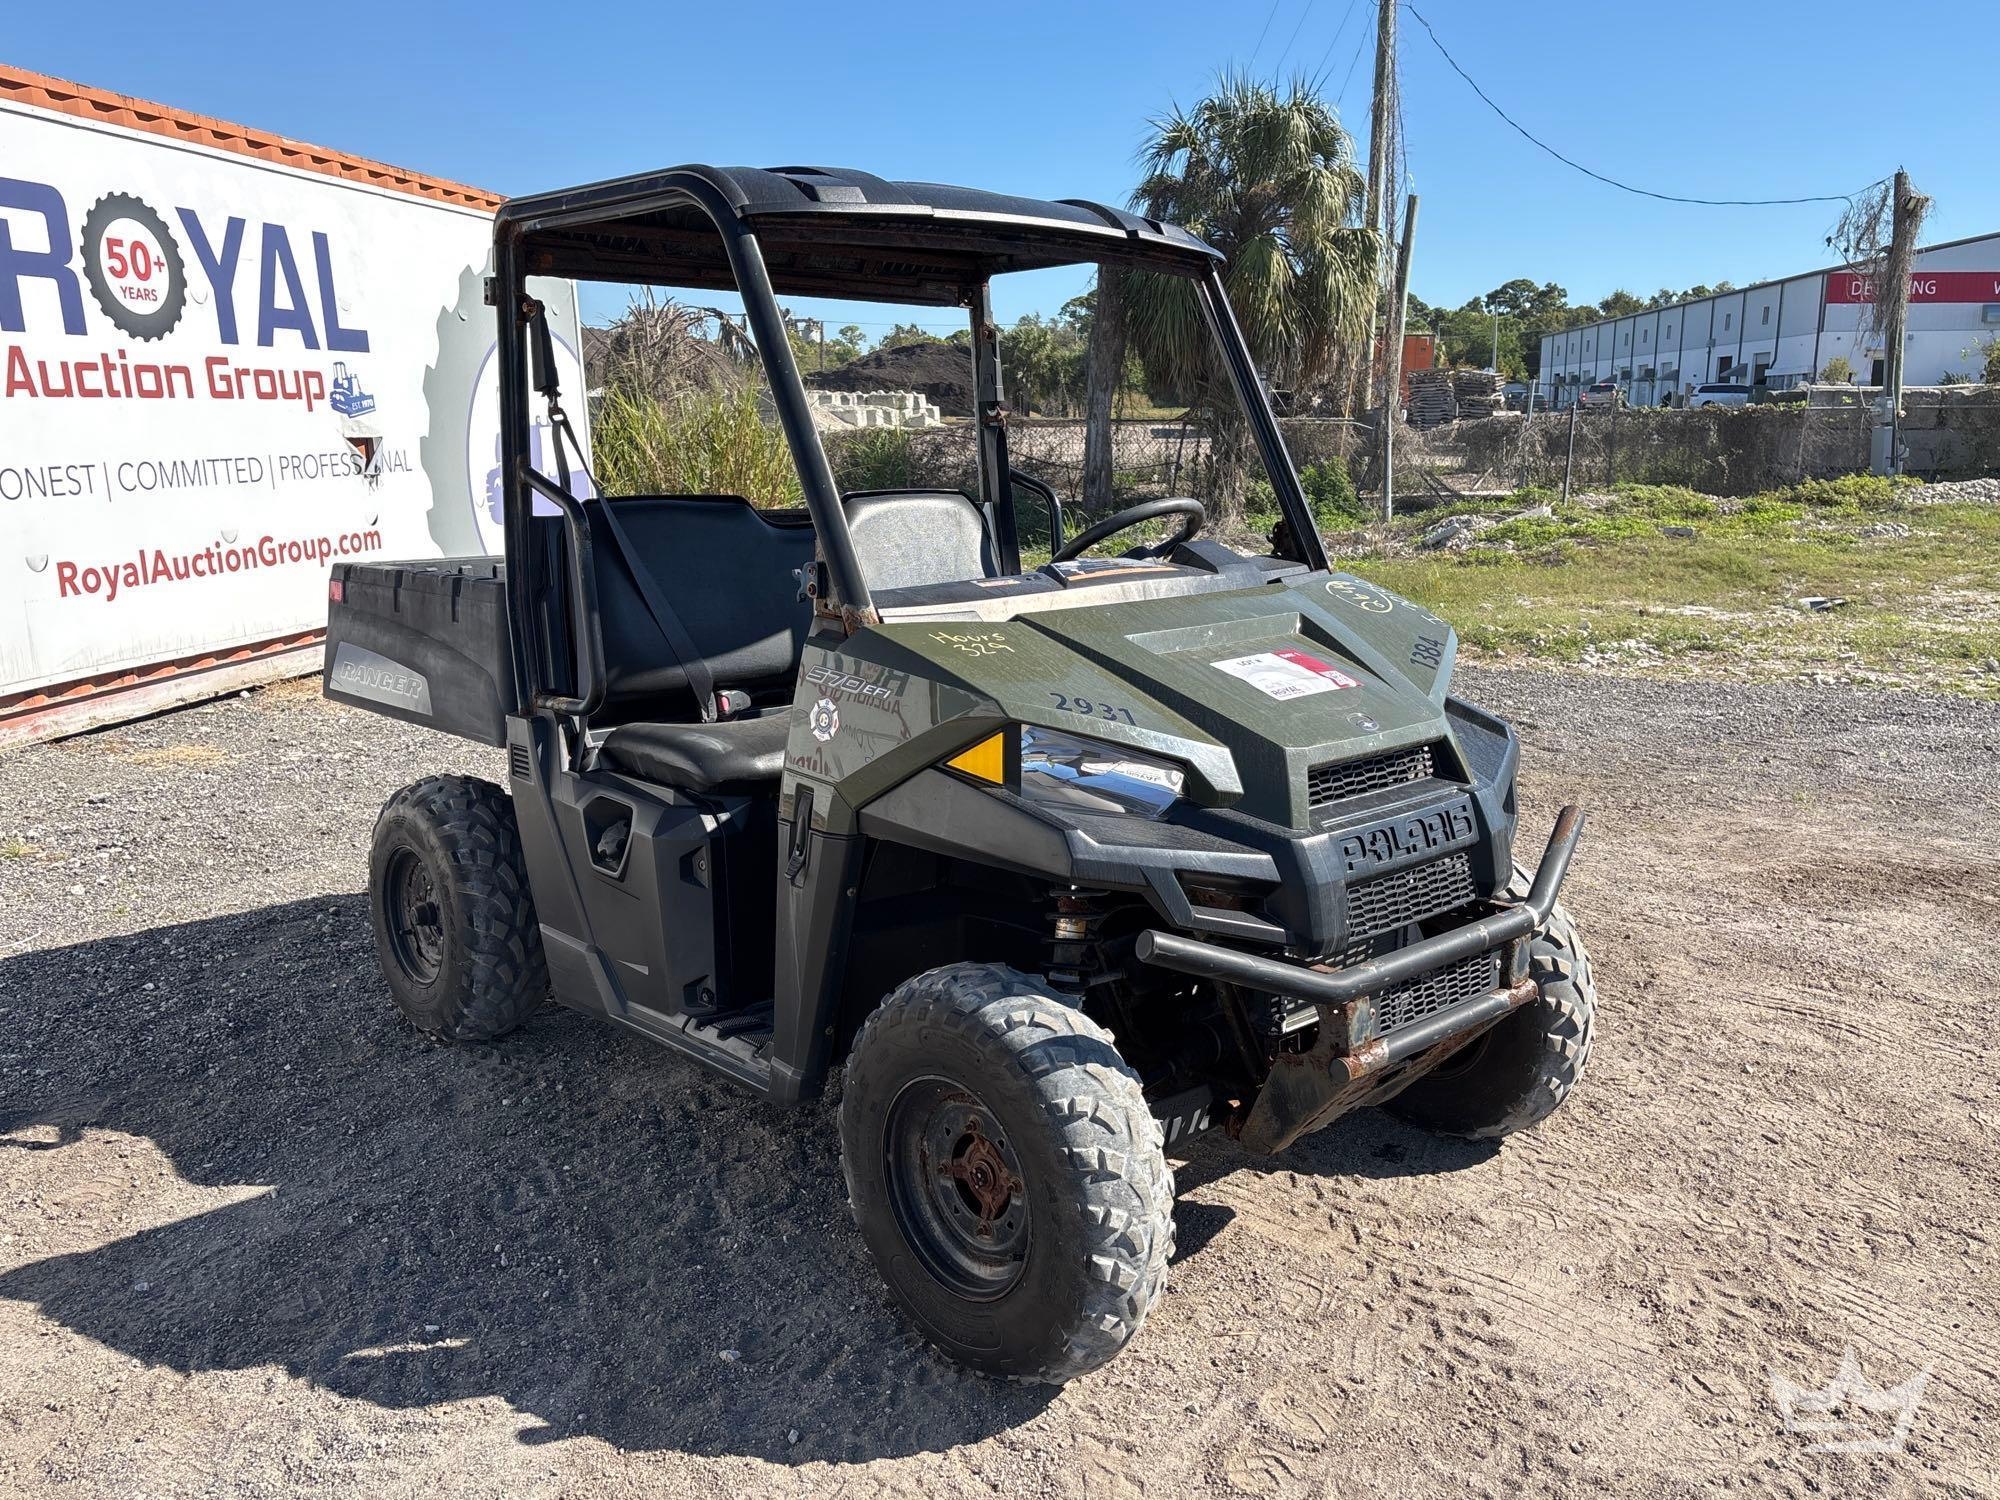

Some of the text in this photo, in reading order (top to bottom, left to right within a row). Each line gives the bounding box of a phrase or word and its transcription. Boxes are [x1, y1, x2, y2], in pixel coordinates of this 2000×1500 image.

[0, 177, 370, 353] ROYAL
[105, 237, 165, 281] 50+
[119, 286, 158, 302] YEARS
[1851, 280, 1937, 296] DETING
[5, 345, 325, 412] Auction Group
[117, 457, 264, 491] COMMITTED
[279, 449, 413, 481] PROFESSNAL
[56, 529, 382, 602] RoyalAuctionGroup.com
[928, 631, 1006, 645] Hours
[953, 642, 1015, 657] 329
[1409, 635, 1445, 671] 1384
[339, 661, 423, 698] RANGER
[806, 664, 867, 693] 570
[863, 684, 892, 699] EFI
[1049, 692, 1137, 725] 2931
[1338, 804, 1473, 873] POLARIS
